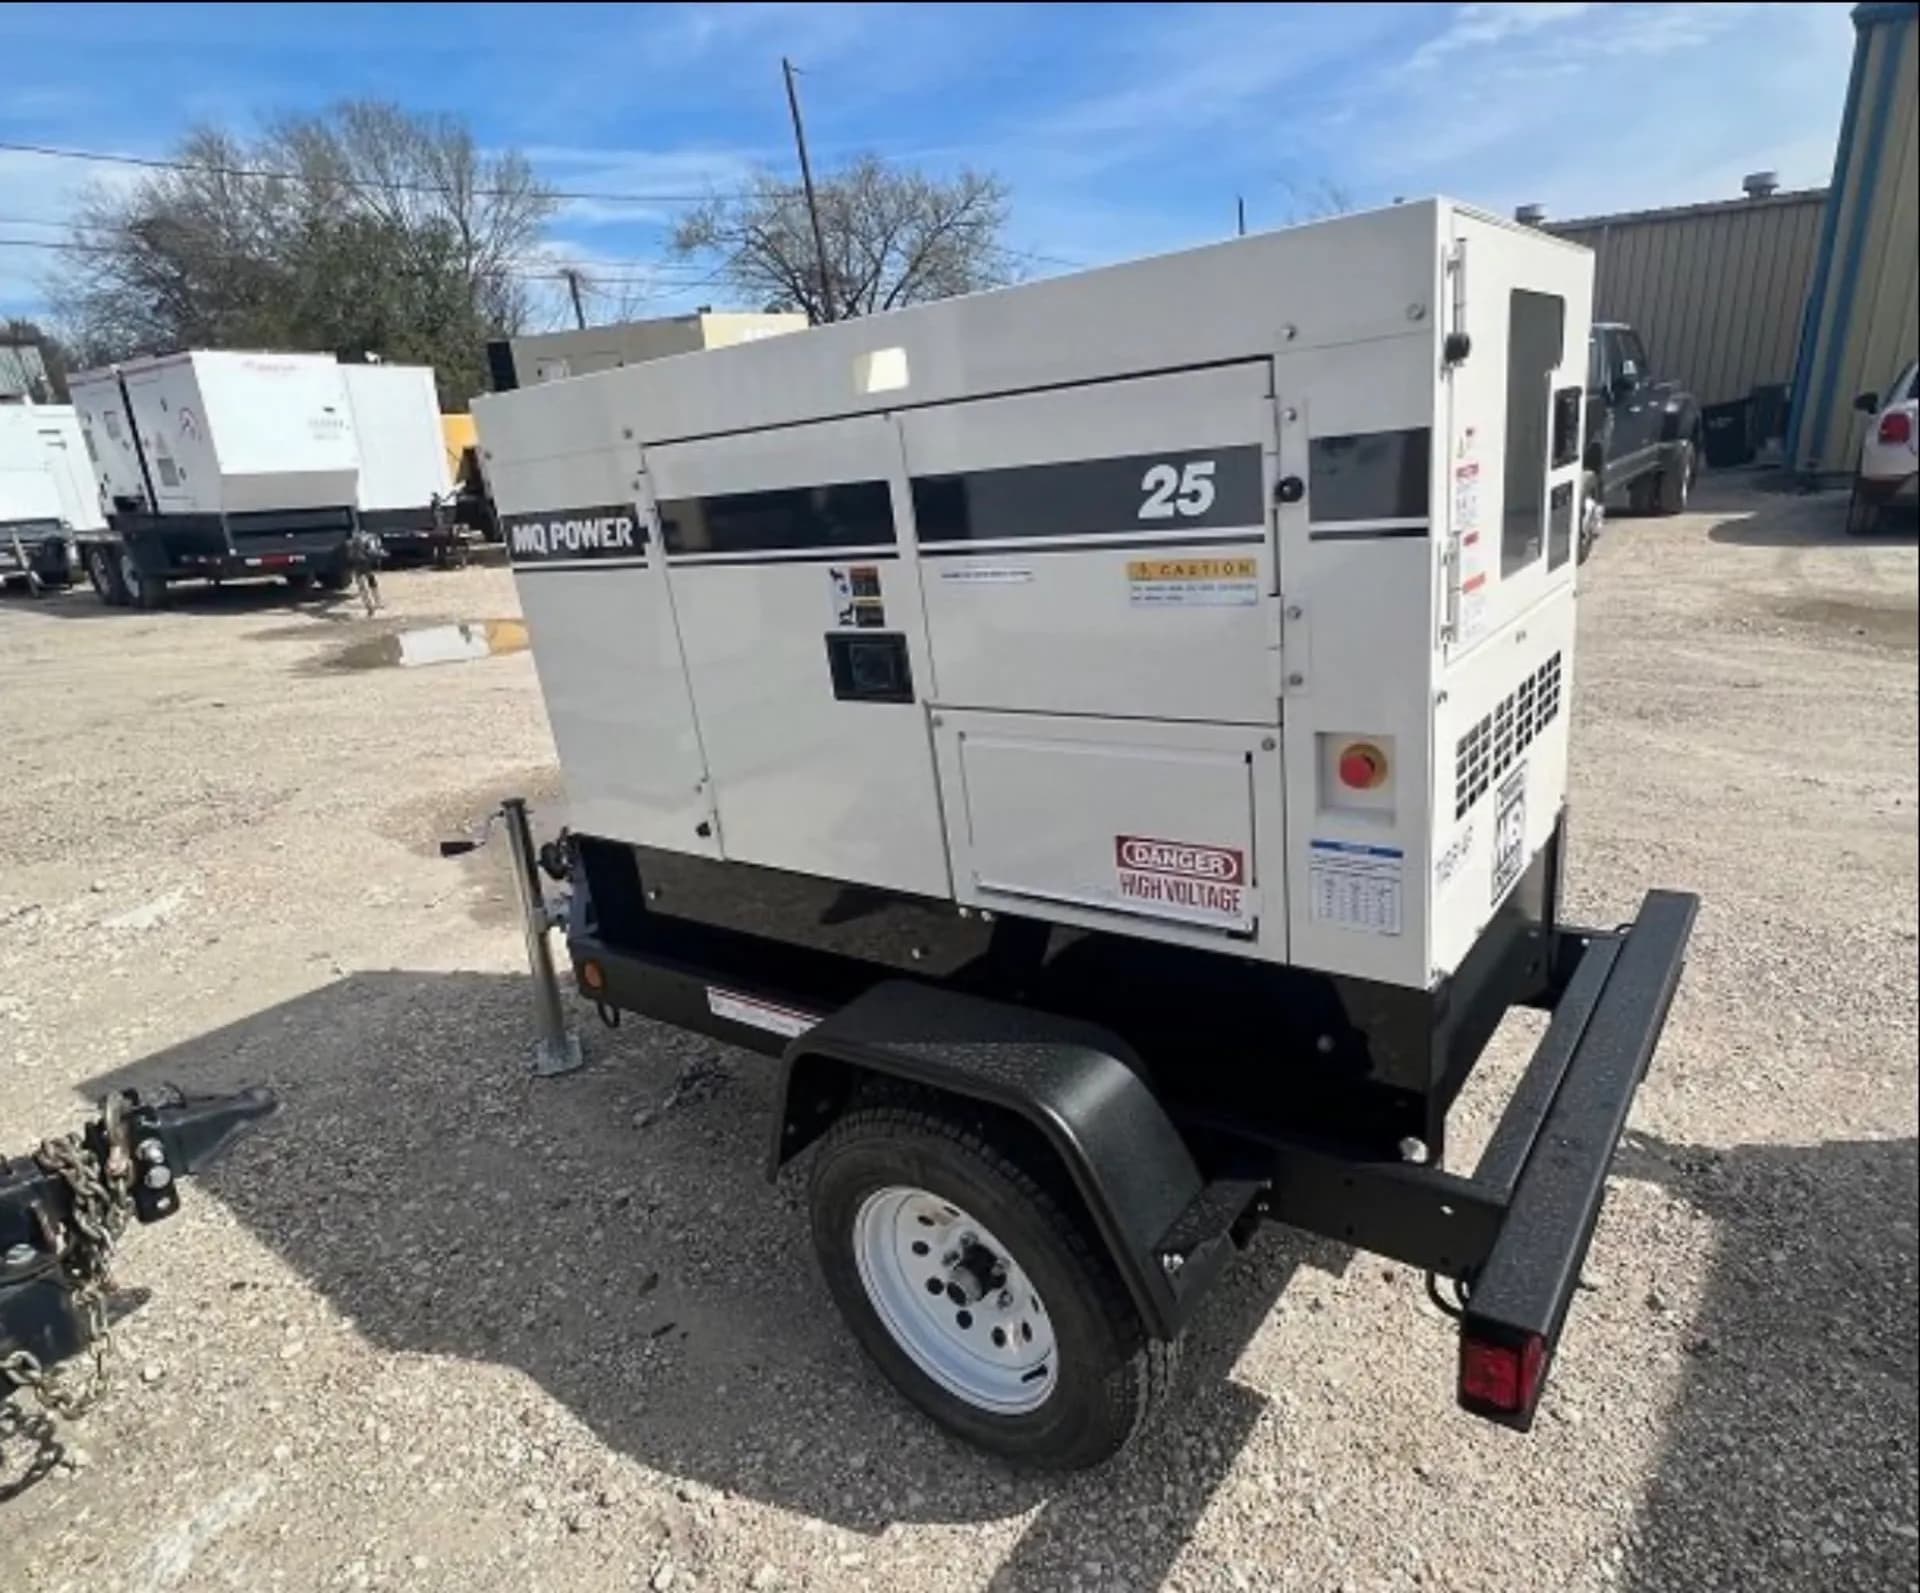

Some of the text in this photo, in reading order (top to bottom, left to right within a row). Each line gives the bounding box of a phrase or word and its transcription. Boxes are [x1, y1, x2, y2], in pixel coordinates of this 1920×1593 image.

[1138, 460, 1216, 519] 25
[512, 517, 633, 554] MQ POWER
[1160, 561, 1251, 575] CAUTION
[1135, 846, 1225, 875] DANGER
[1121, 873, 1241, 912] HIGH VOLTAGE
